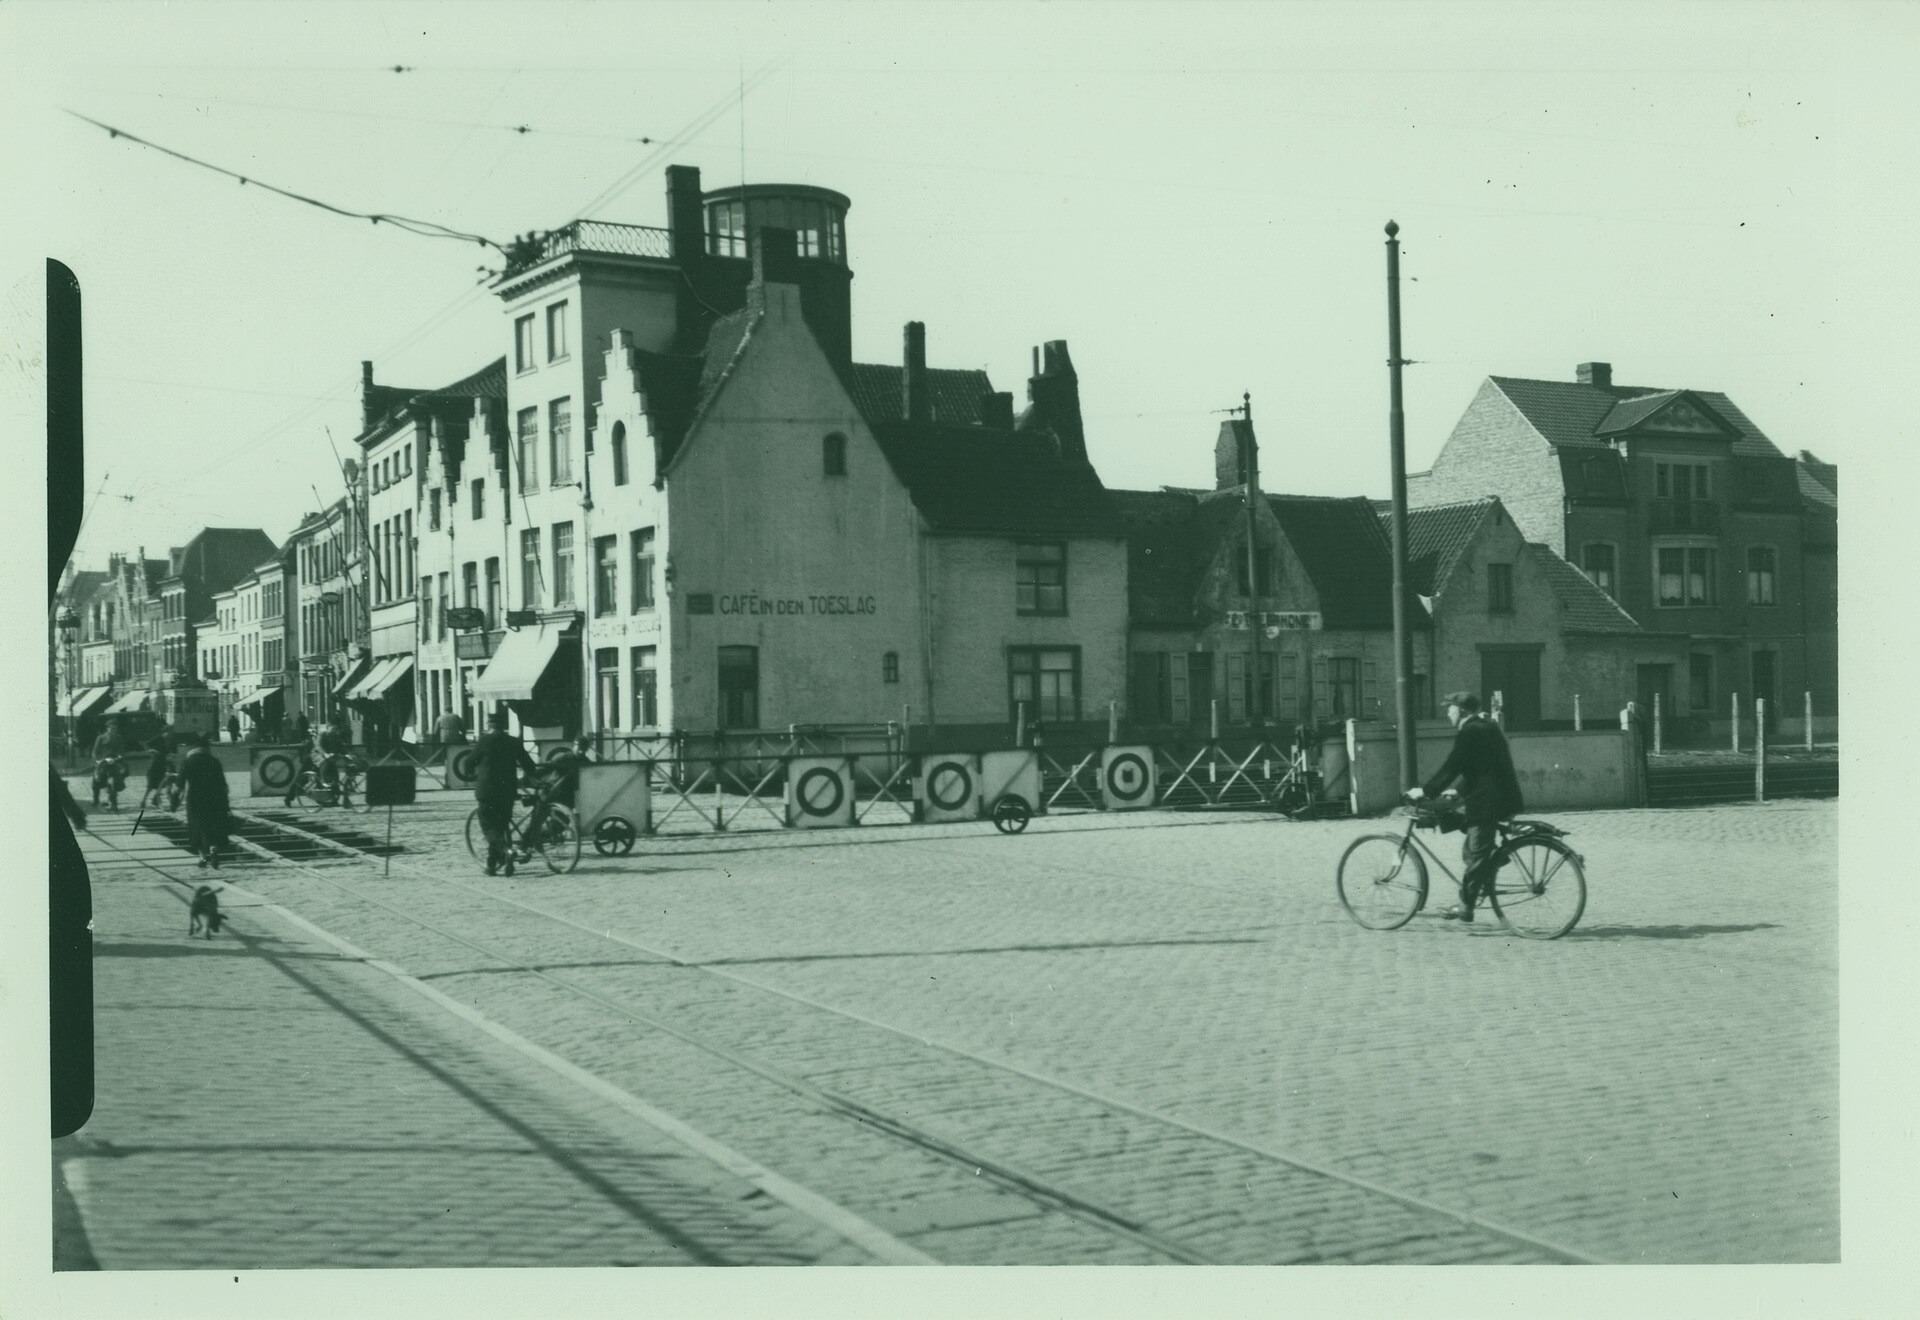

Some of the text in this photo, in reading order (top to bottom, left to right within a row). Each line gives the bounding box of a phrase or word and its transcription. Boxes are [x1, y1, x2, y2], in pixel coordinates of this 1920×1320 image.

[760, 600, 773, 615] IN
[777, 600, 804, 615] DEN
[808, 595, 876, 615] TOESLAG
